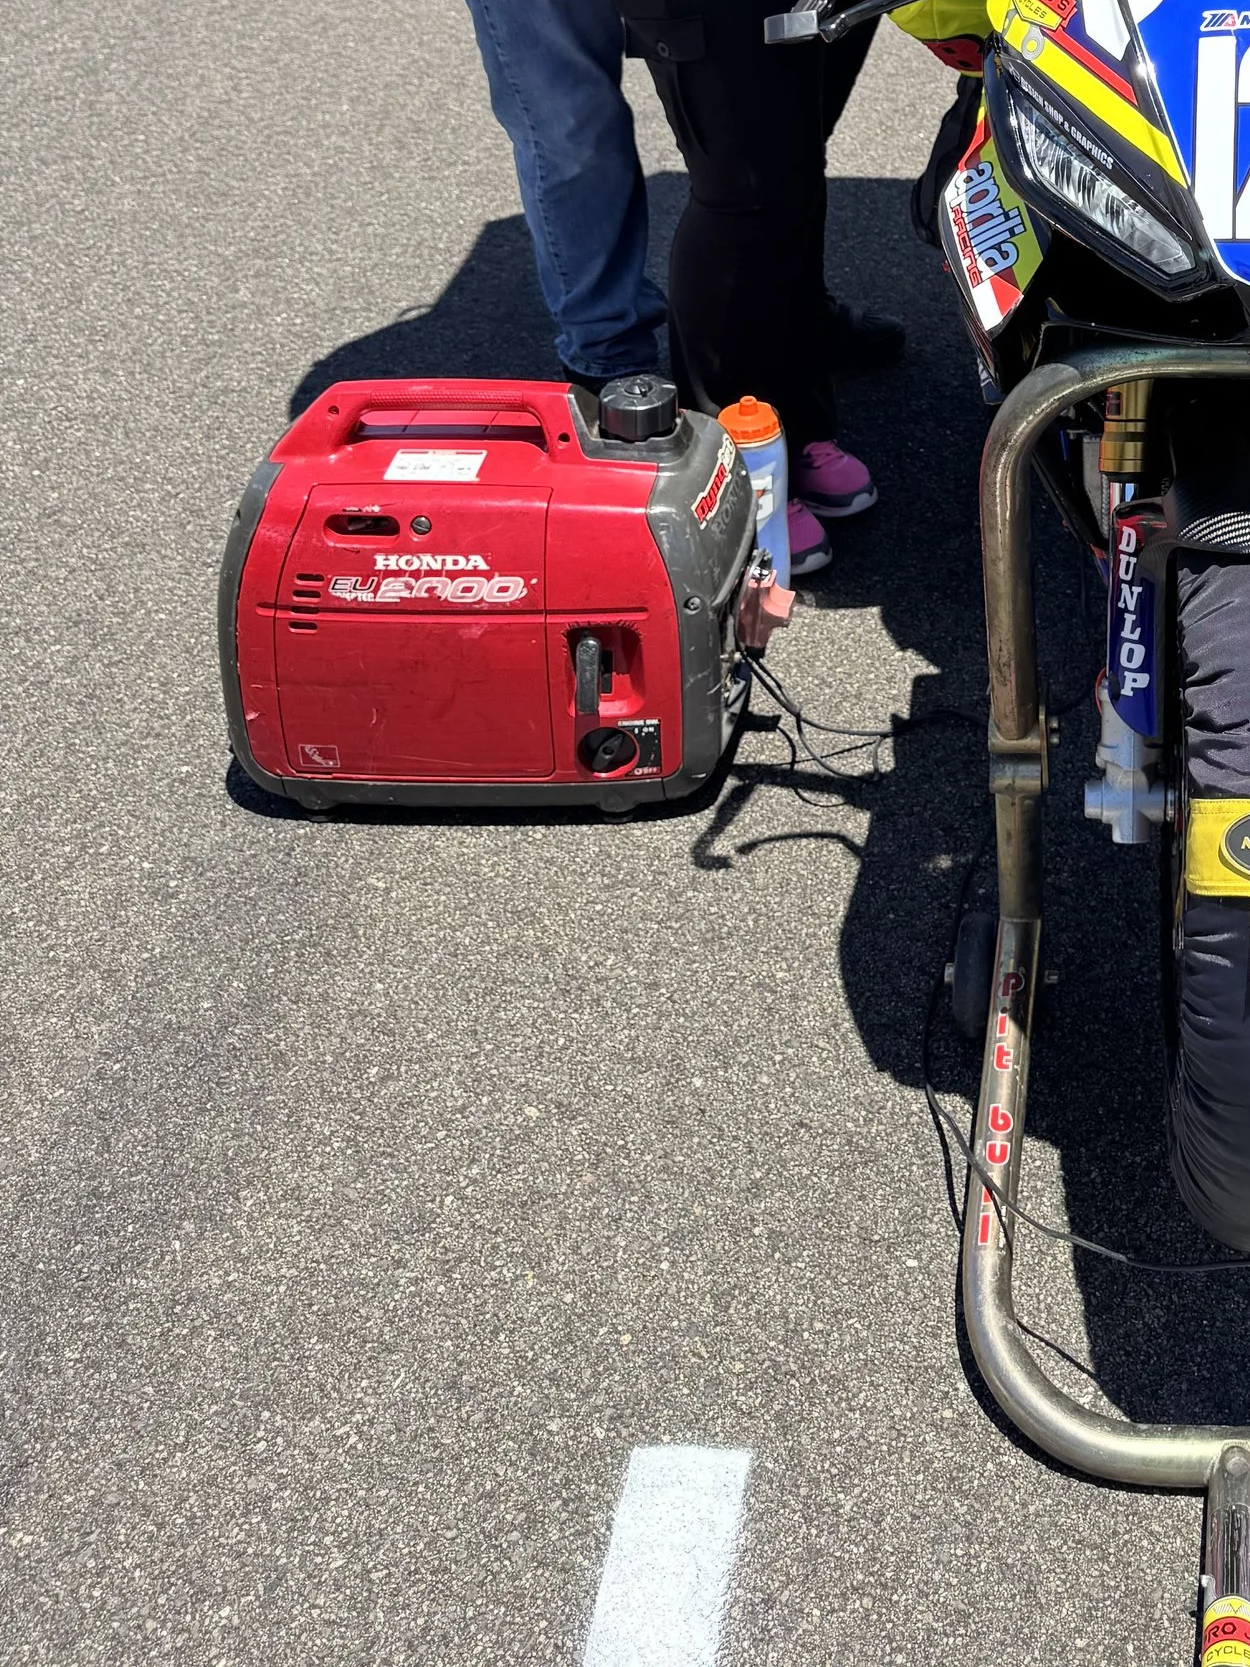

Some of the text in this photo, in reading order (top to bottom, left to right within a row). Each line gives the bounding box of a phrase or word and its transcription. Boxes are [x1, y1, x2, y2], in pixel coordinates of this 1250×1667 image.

[1020, 77, 1115, 172] DESIGN SHOP & GRAPHICS
[952, 205, 984, 289] RACING
[956, 160, 1026, 273] aprilia
[330, 576, 528, 603] EU 2000
[374, 554, 490, 572] HONDA
[1118, 525, 1150, 697] DUNLOP
[991, 971, 1026, 1072] pit
[1204, 1621, 1238, 1641] RO
